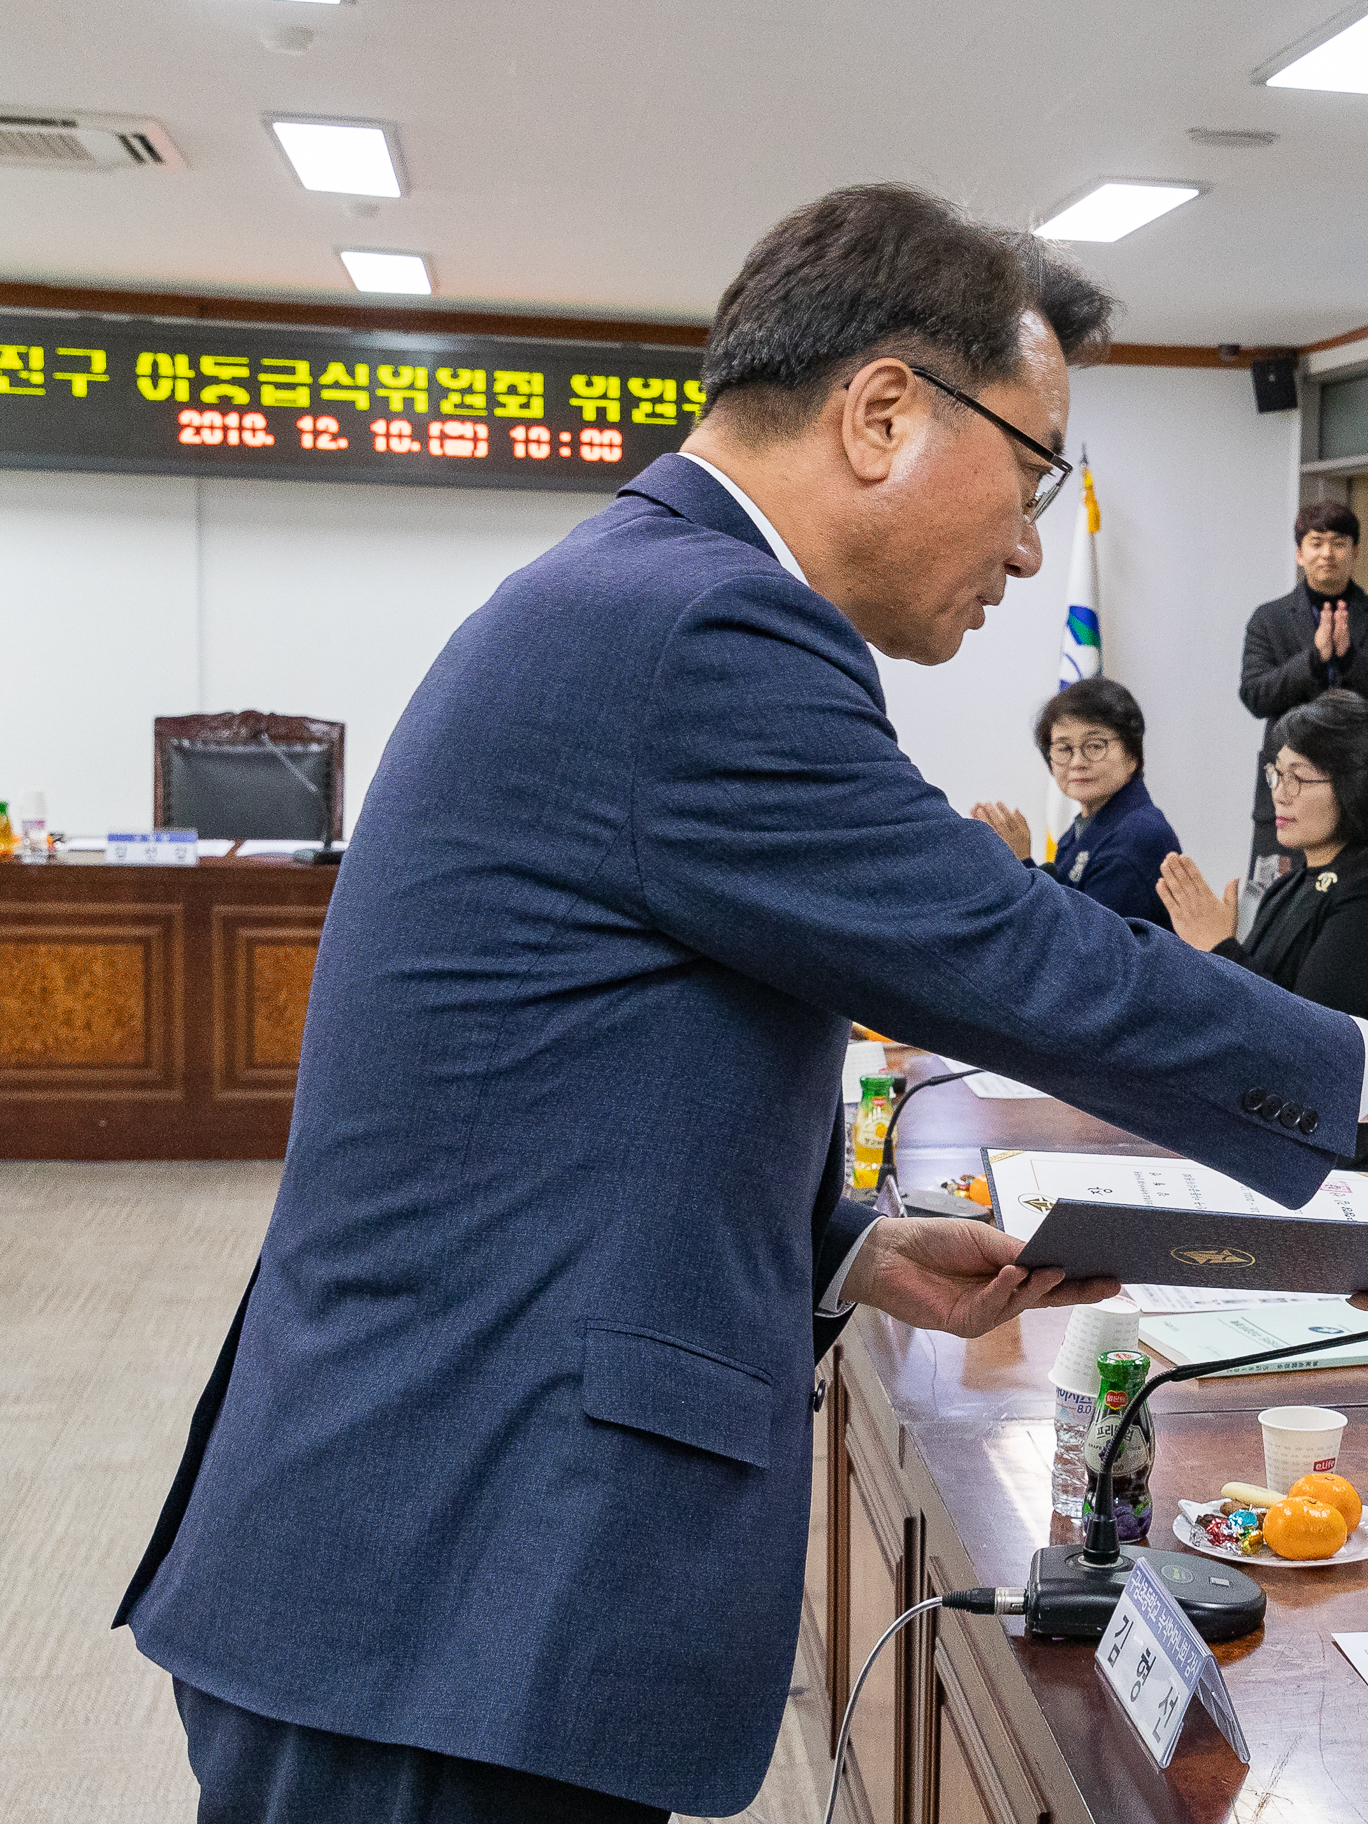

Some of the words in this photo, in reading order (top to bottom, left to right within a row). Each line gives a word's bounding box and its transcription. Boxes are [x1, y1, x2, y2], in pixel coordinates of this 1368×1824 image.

[135, 351, 544, 419] 아동급식위원회
[296, 414, 349, 451] 12.
[1077, 1404, 1092, 1414] 8.0
